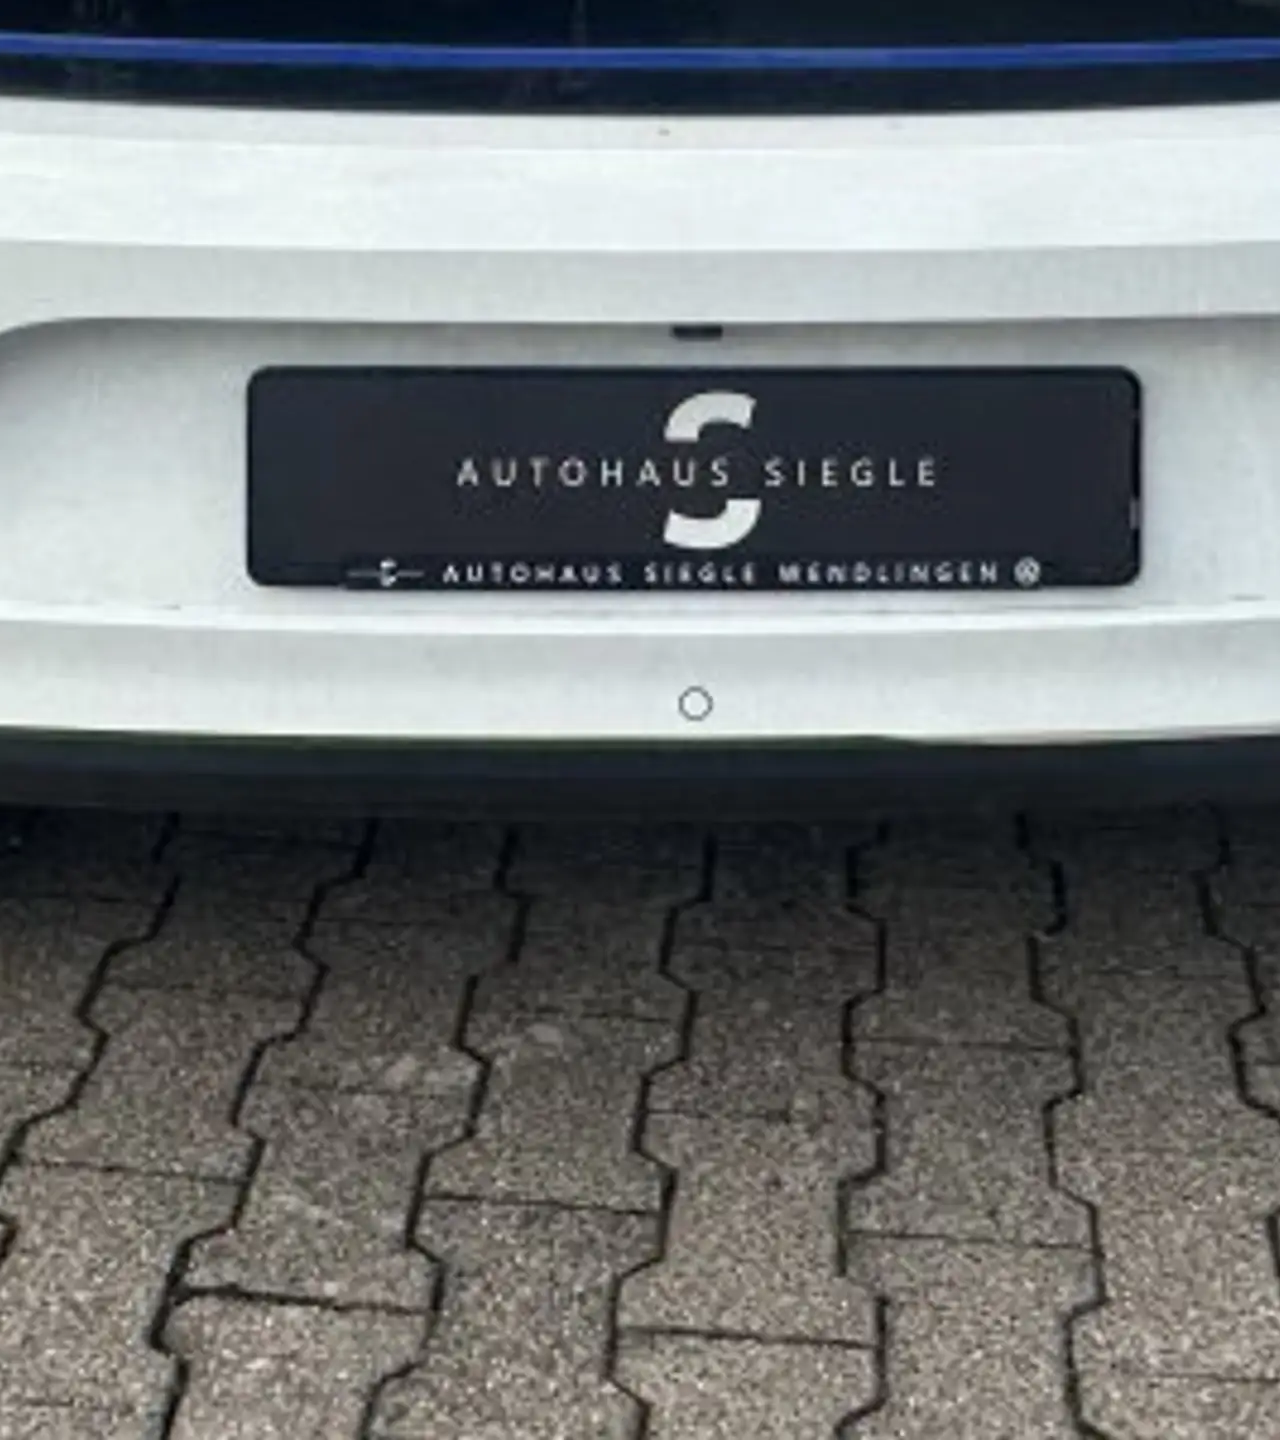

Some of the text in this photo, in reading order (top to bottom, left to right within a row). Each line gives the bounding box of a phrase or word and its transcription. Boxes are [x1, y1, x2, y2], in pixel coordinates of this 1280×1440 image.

[455, 457, 938, 489] AUTOHAUS SIEGLE
[441, 561, 622, 586] AUTOHAUS
[642, 561, 756, 585] SIEGLE
